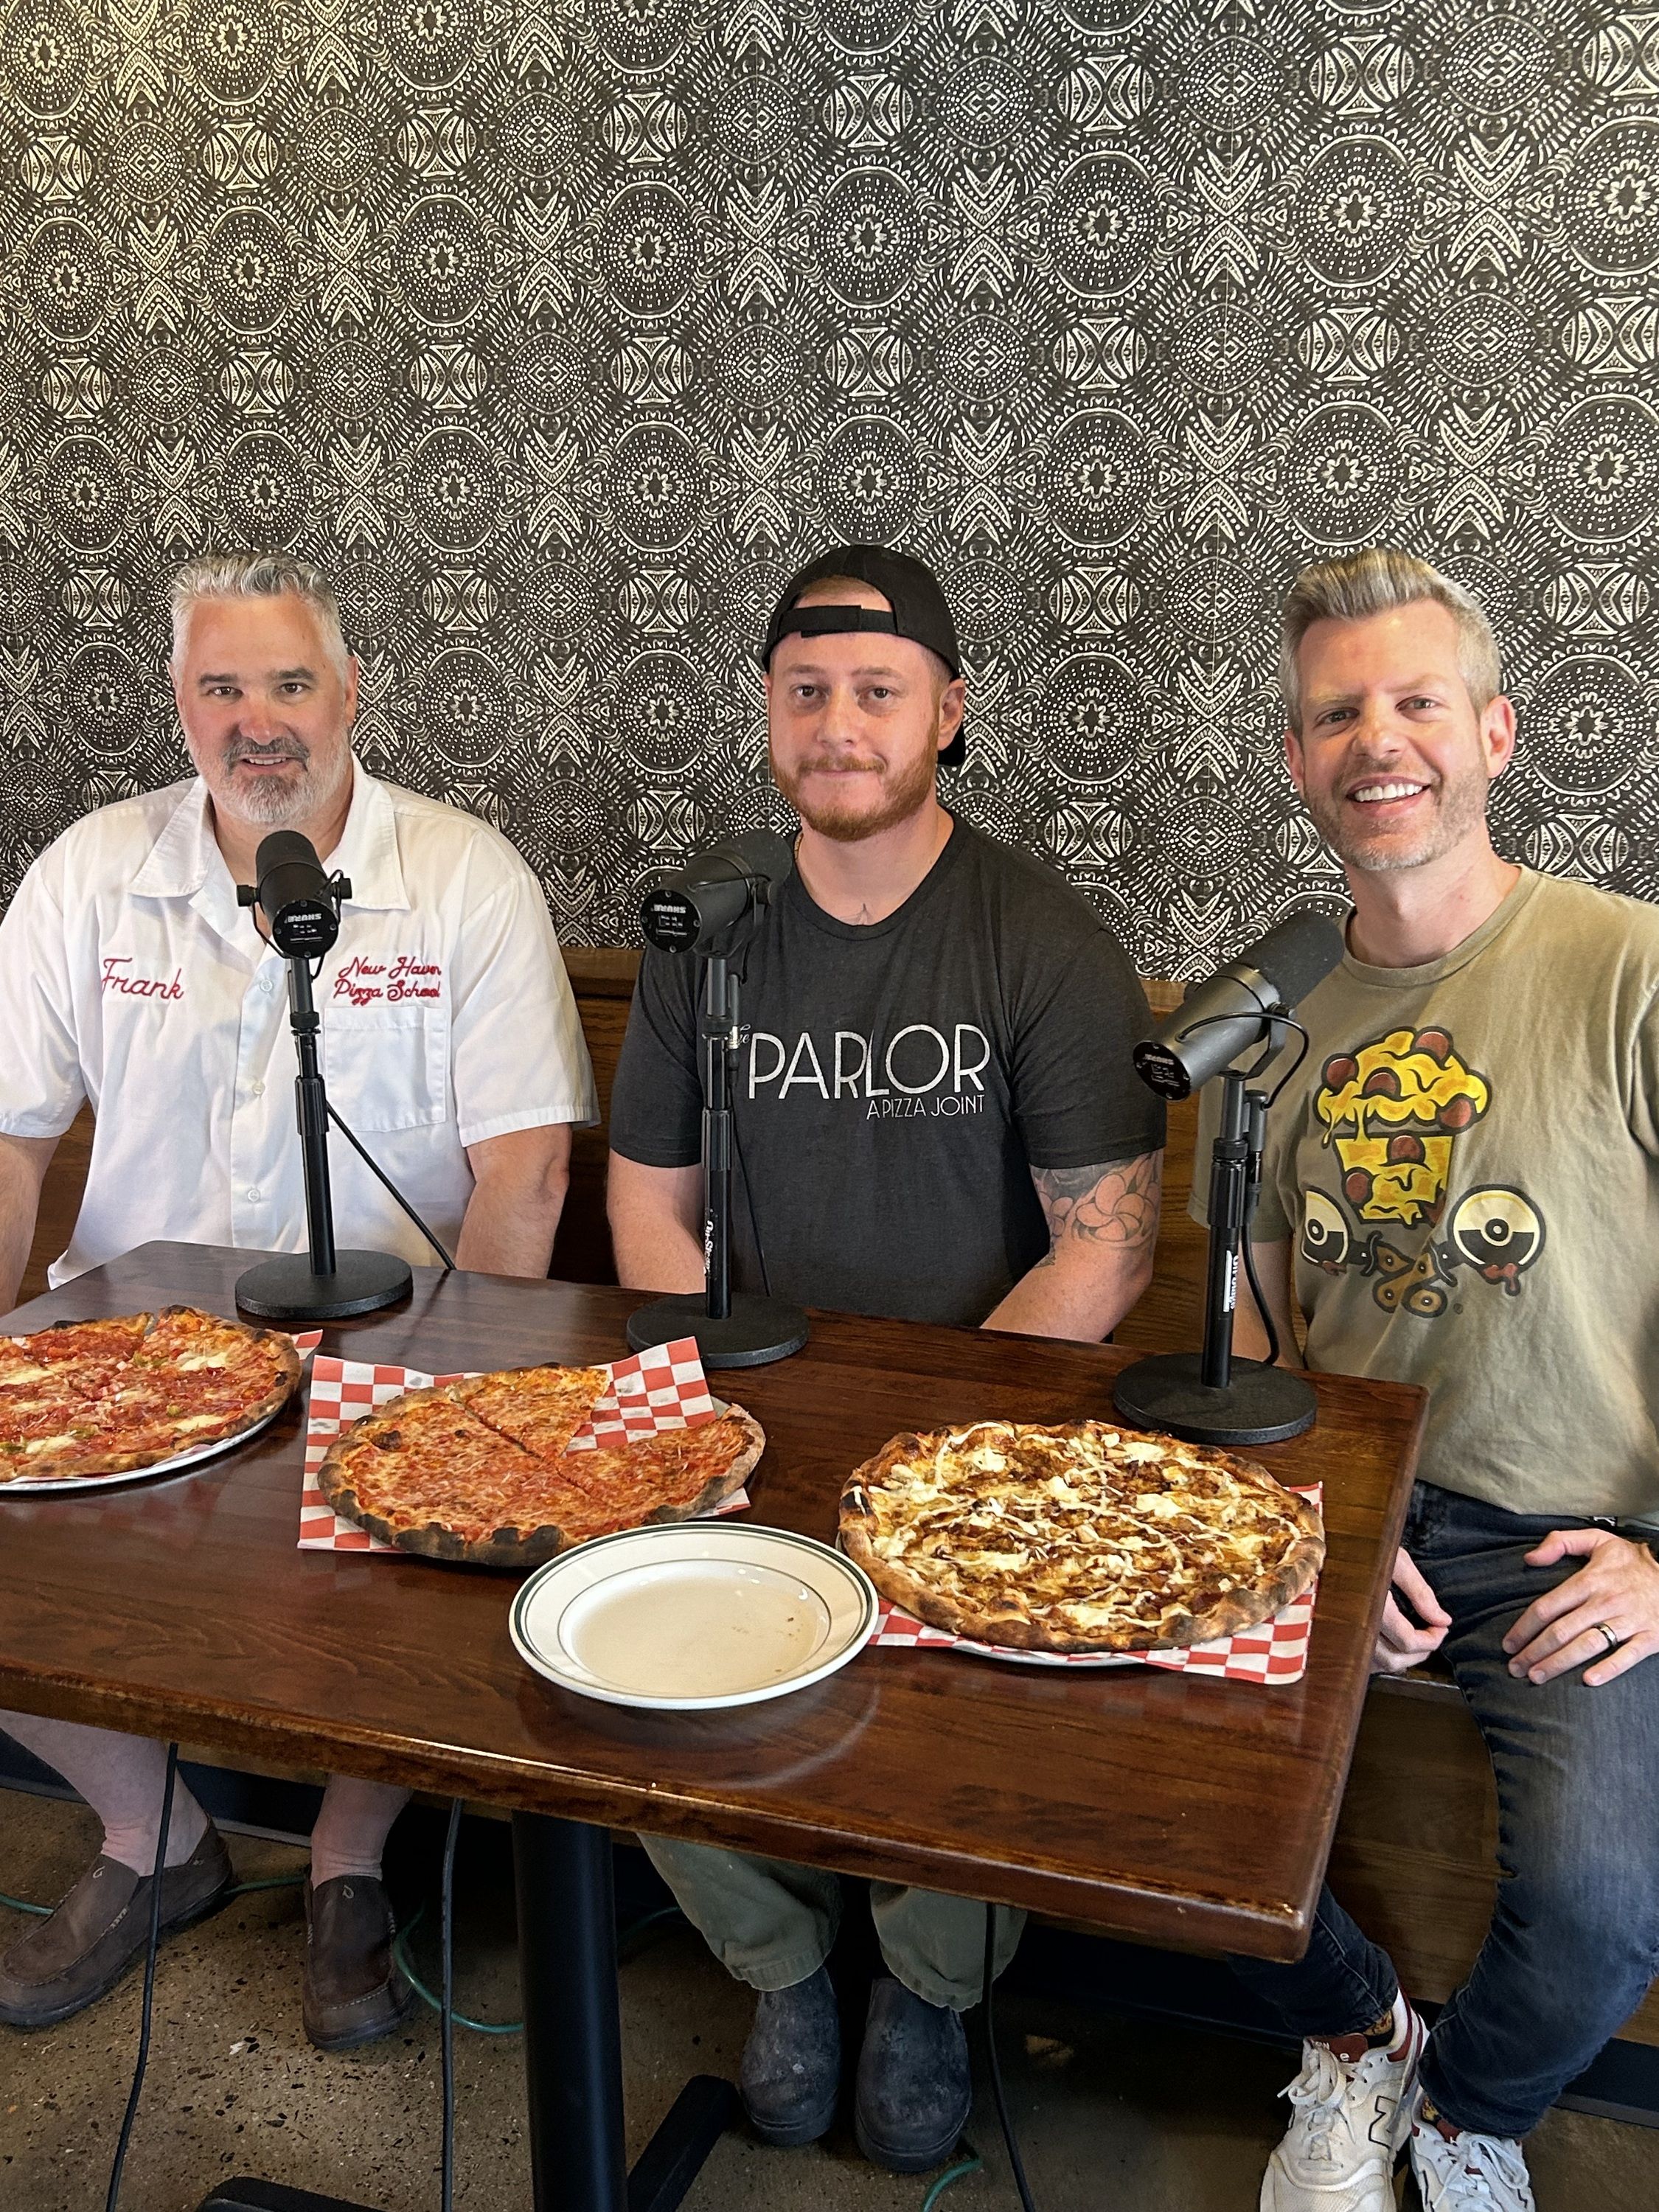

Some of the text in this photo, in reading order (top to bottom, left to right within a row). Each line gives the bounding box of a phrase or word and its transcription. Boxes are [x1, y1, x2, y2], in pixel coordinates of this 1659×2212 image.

[102, 957, 184, 1000] Frank
[338, 956, 386, 979] New
[333, 978, 383, 1006] Pizza
[748, 1023, 991, 1099] PARLOR
[930, 1094, 985, 1117] JOINT
